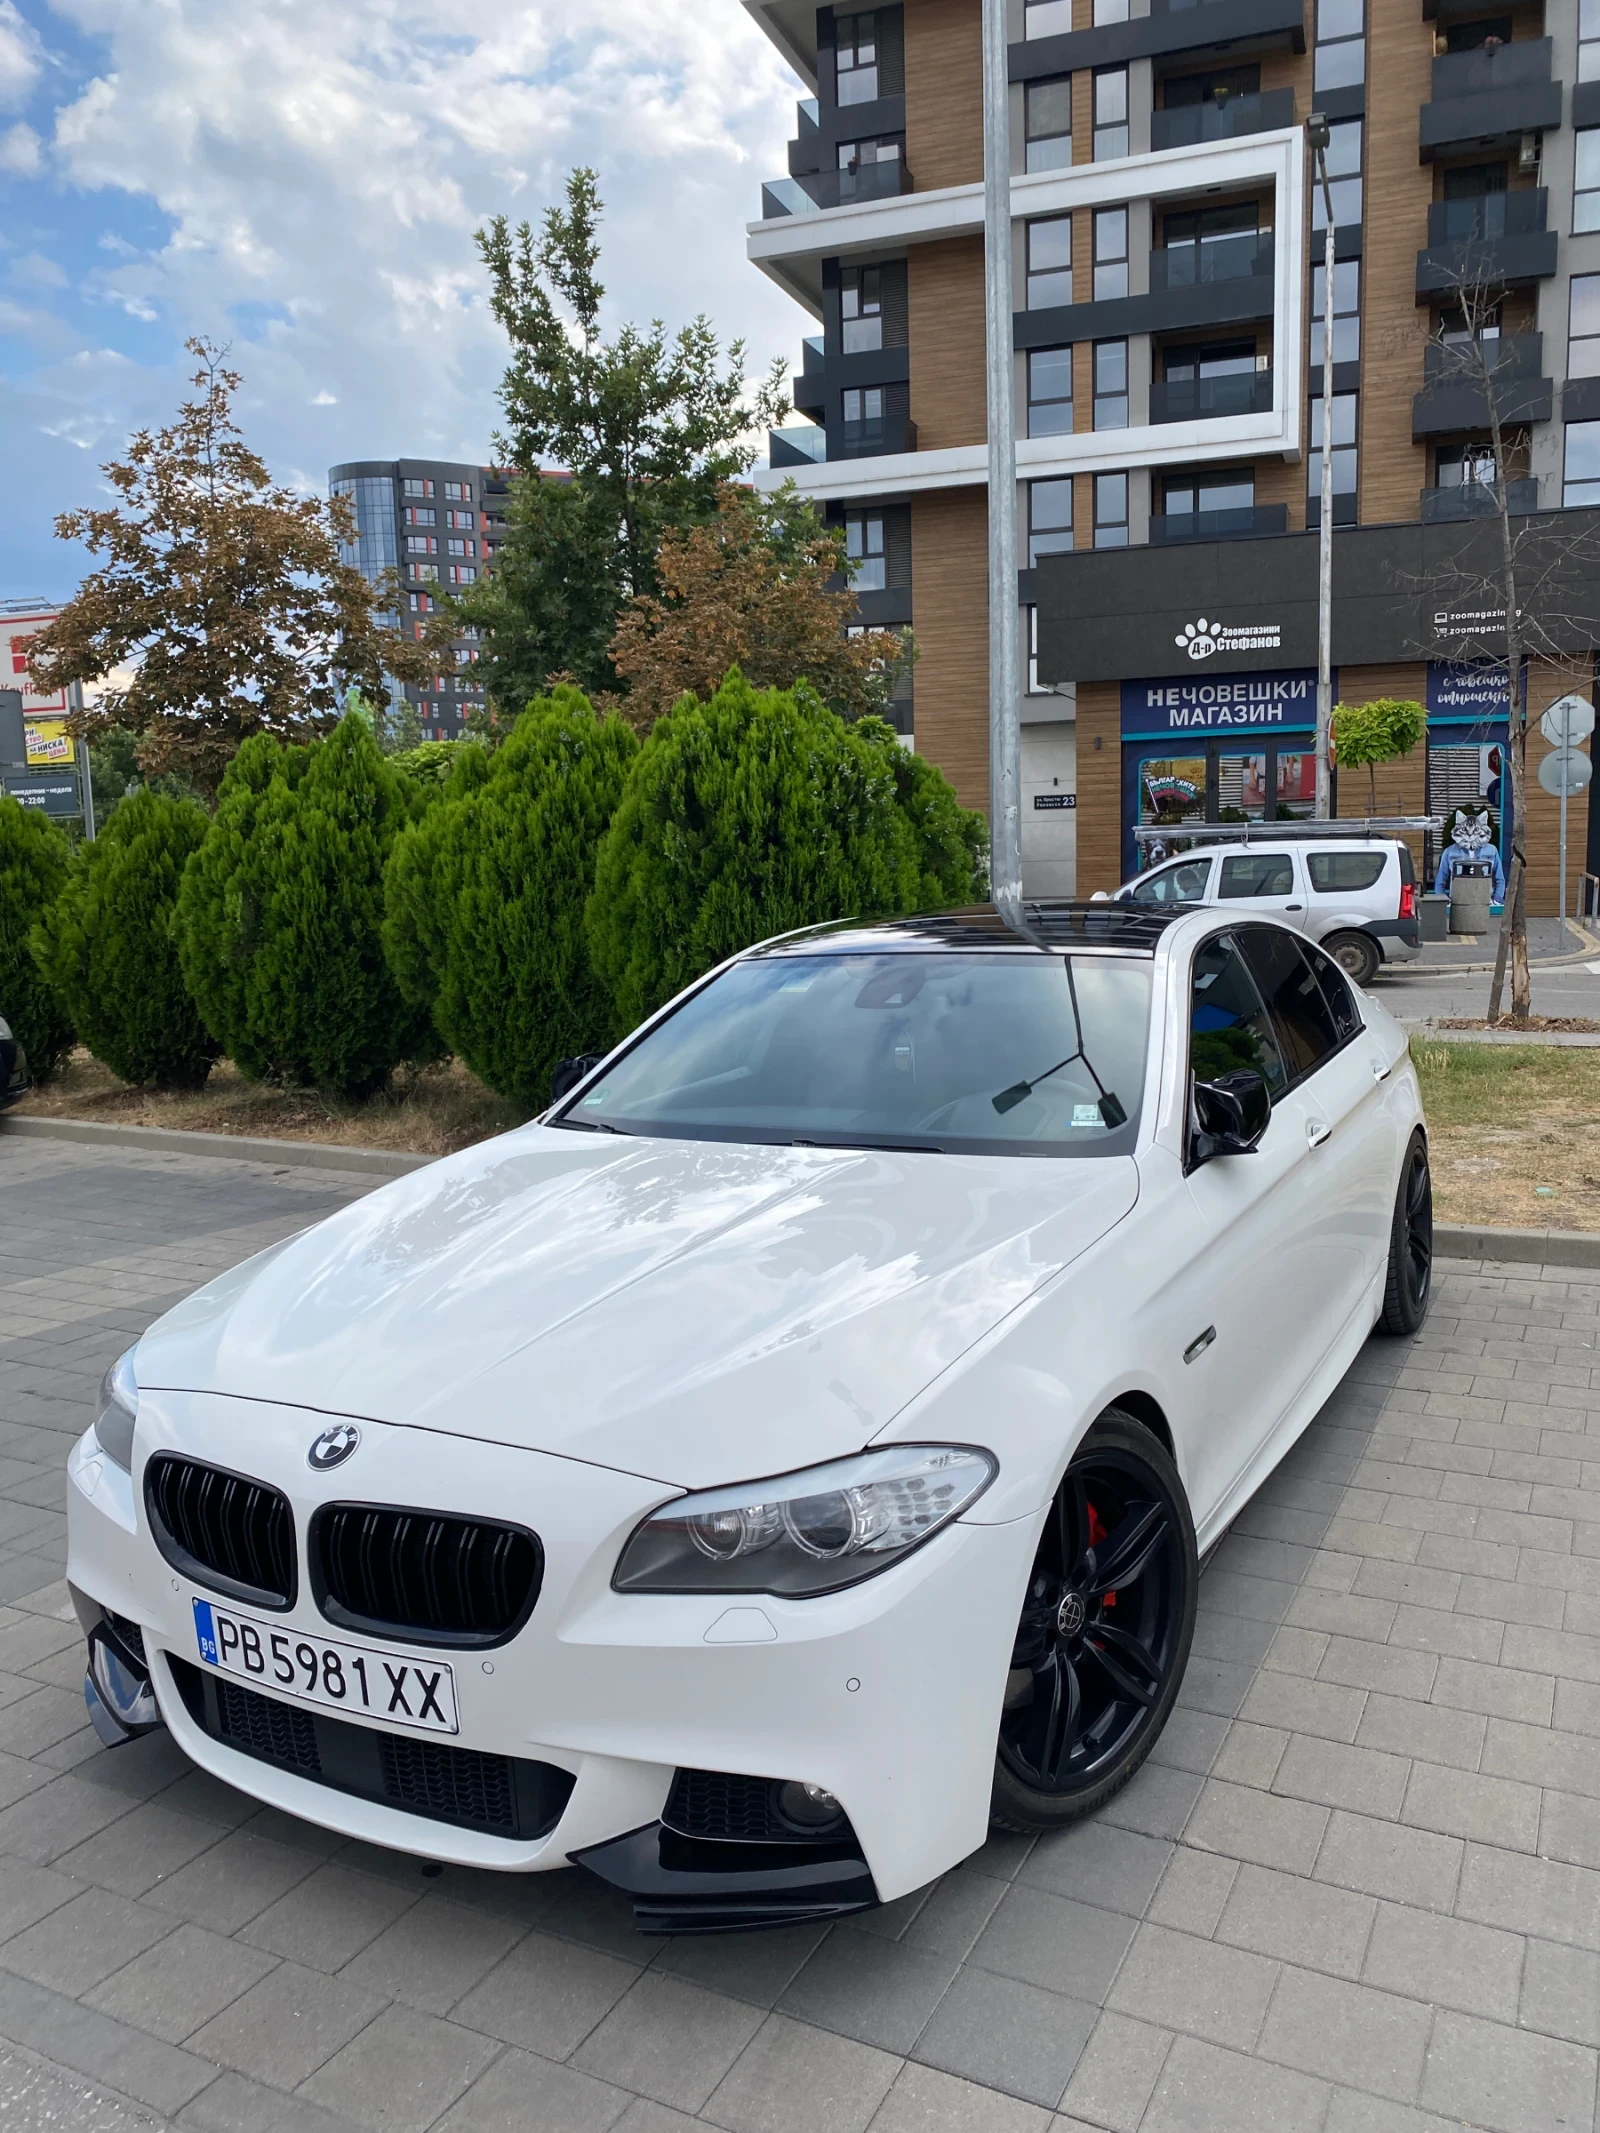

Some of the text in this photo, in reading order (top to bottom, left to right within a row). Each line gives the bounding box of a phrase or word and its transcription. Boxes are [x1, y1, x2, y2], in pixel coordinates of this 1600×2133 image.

[1222, 625, 1280, 637] Зоомагазини
[1191, 636, 1281, 655] Д-р Стефанов
[1147, 680, 1307, 707] НЕЧОВЕШКИ
[1169, 702, 1283, 727] МАГАЗИН
[37, 739, 63, 753] НИСКА
[48, 746, 67, 758] ЦЕНА
[1062, 796, 1076, 806] 23
[201, 1636, 216, 1655] BG
[216, 1615, 447, 1723] PB 5981 XX
